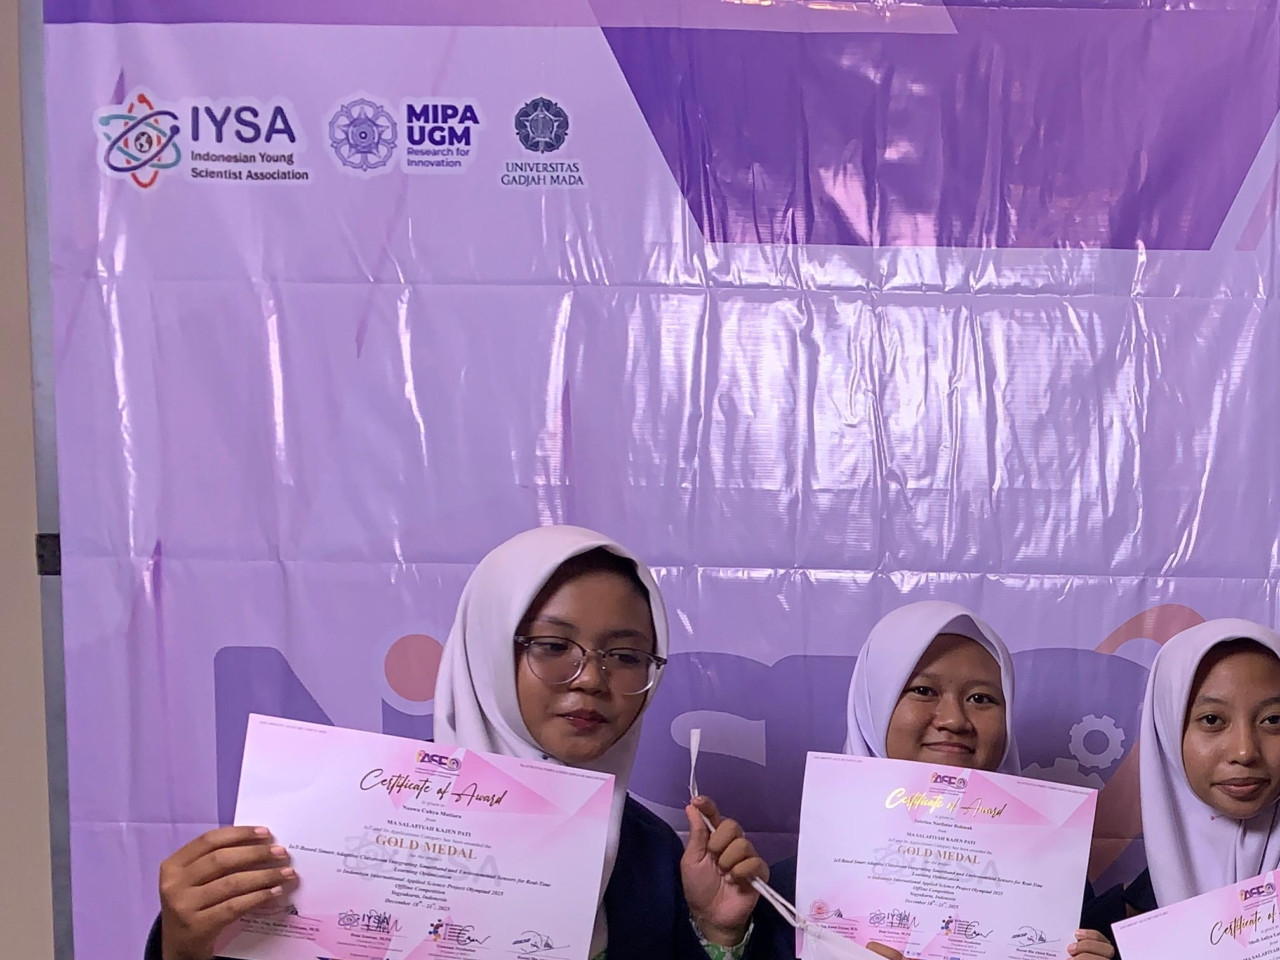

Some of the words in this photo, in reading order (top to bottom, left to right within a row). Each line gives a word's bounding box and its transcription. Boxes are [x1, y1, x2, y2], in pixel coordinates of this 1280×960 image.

[407, 104, 479, 125] MIPA
[190, 106, 297, 144] IYSA
[408, 125, 471, 146] UGM
[190, 151, 256, 164] Indonesian
[259, 152, 294, 166] Young
[407, 147, 453, 158] Research
[455, 147, 470, 158] for
[407, 158, 461, 168] Innovation
[505, 162, 580, 174] UNIVERSITAS
[190, 168, 242, 181] Scientist
[244, 169, 309, 182] Association
[501, 174, 548, 187] GADJAH
[550, 174, 584, 186] MADA
[360, 768, 432, 799] Certificate
[436, 782, 452, 800] of
[451, 783, 508, 806] Award
[375, 834, 420, 851] GOLD
[425, 842, 478, 859] MEDAL
[897, 845, 933, 858] GOLD
[936, 849, 980, 864] MEDAL
[1210, 910, 1262, 945] Certificate
[1268, 904, 1276, 924] of
